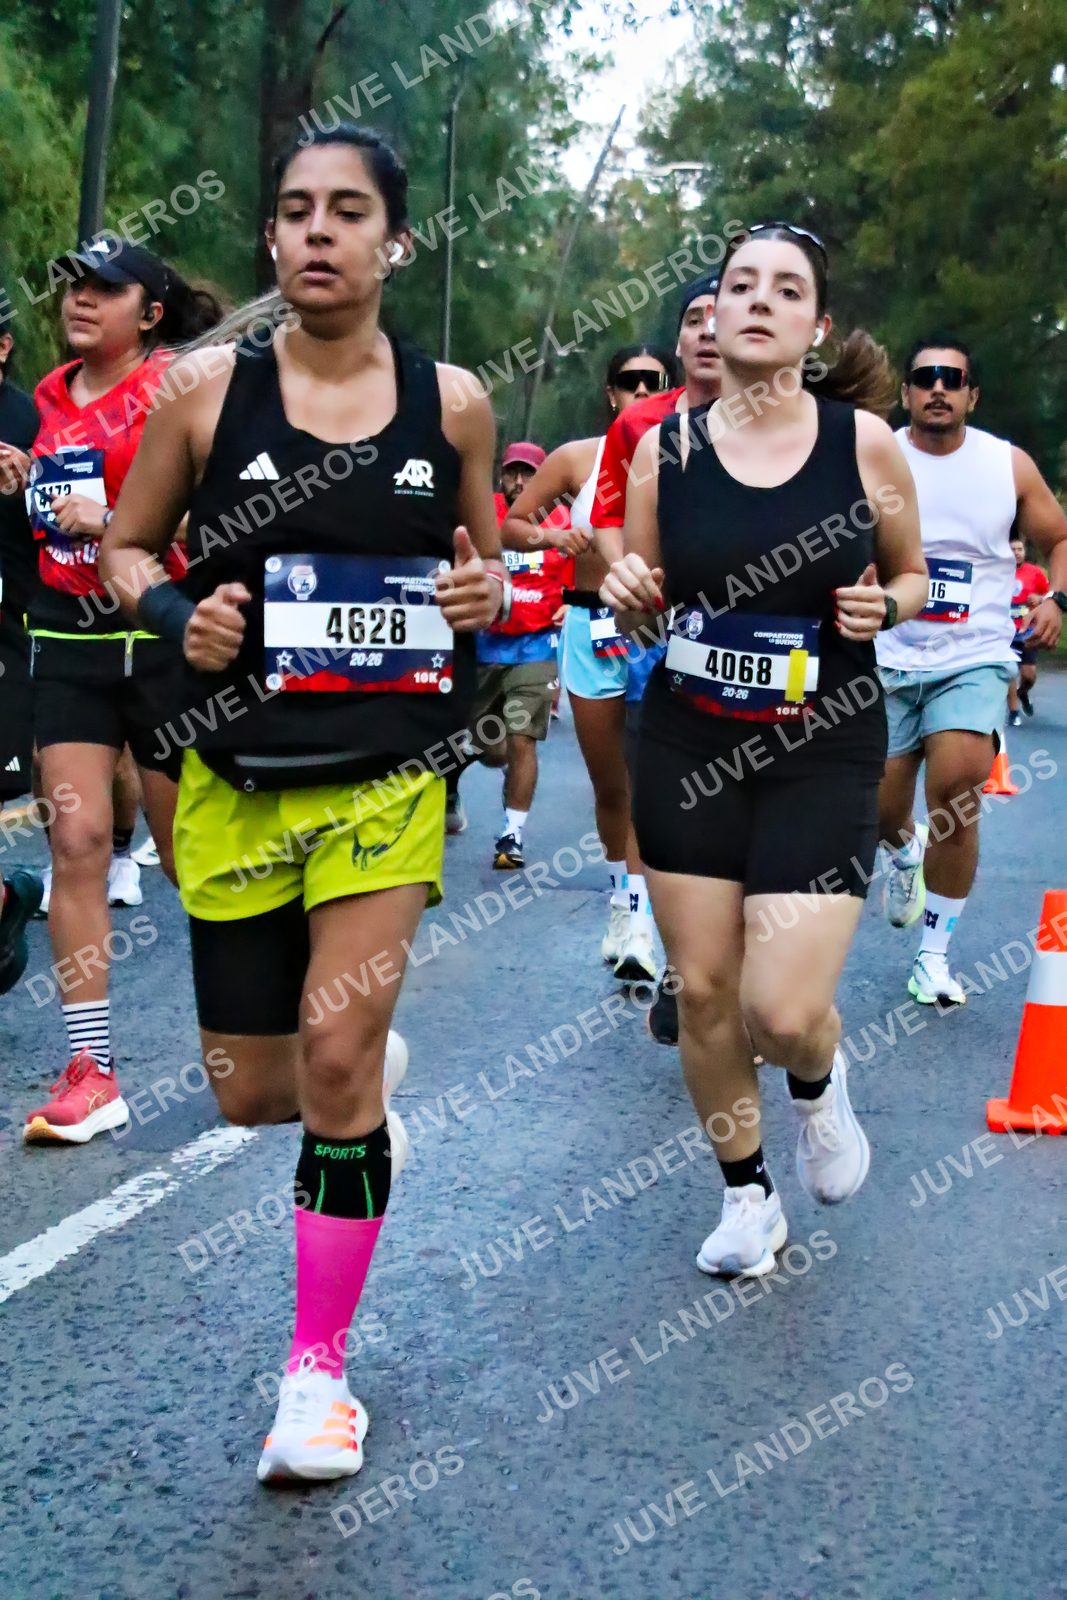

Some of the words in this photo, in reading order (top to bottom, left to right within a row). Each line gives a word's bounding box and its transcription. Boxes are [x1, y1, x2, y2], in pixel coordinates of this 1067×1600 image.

[326, 607, 406, 645] 4628
[705, 649, 772, 686] 4068
[413, 672, 438, 684] 10K
[775, 706, 799, 716] 10K
[314, 1144, 367, 1160] SPORTS
